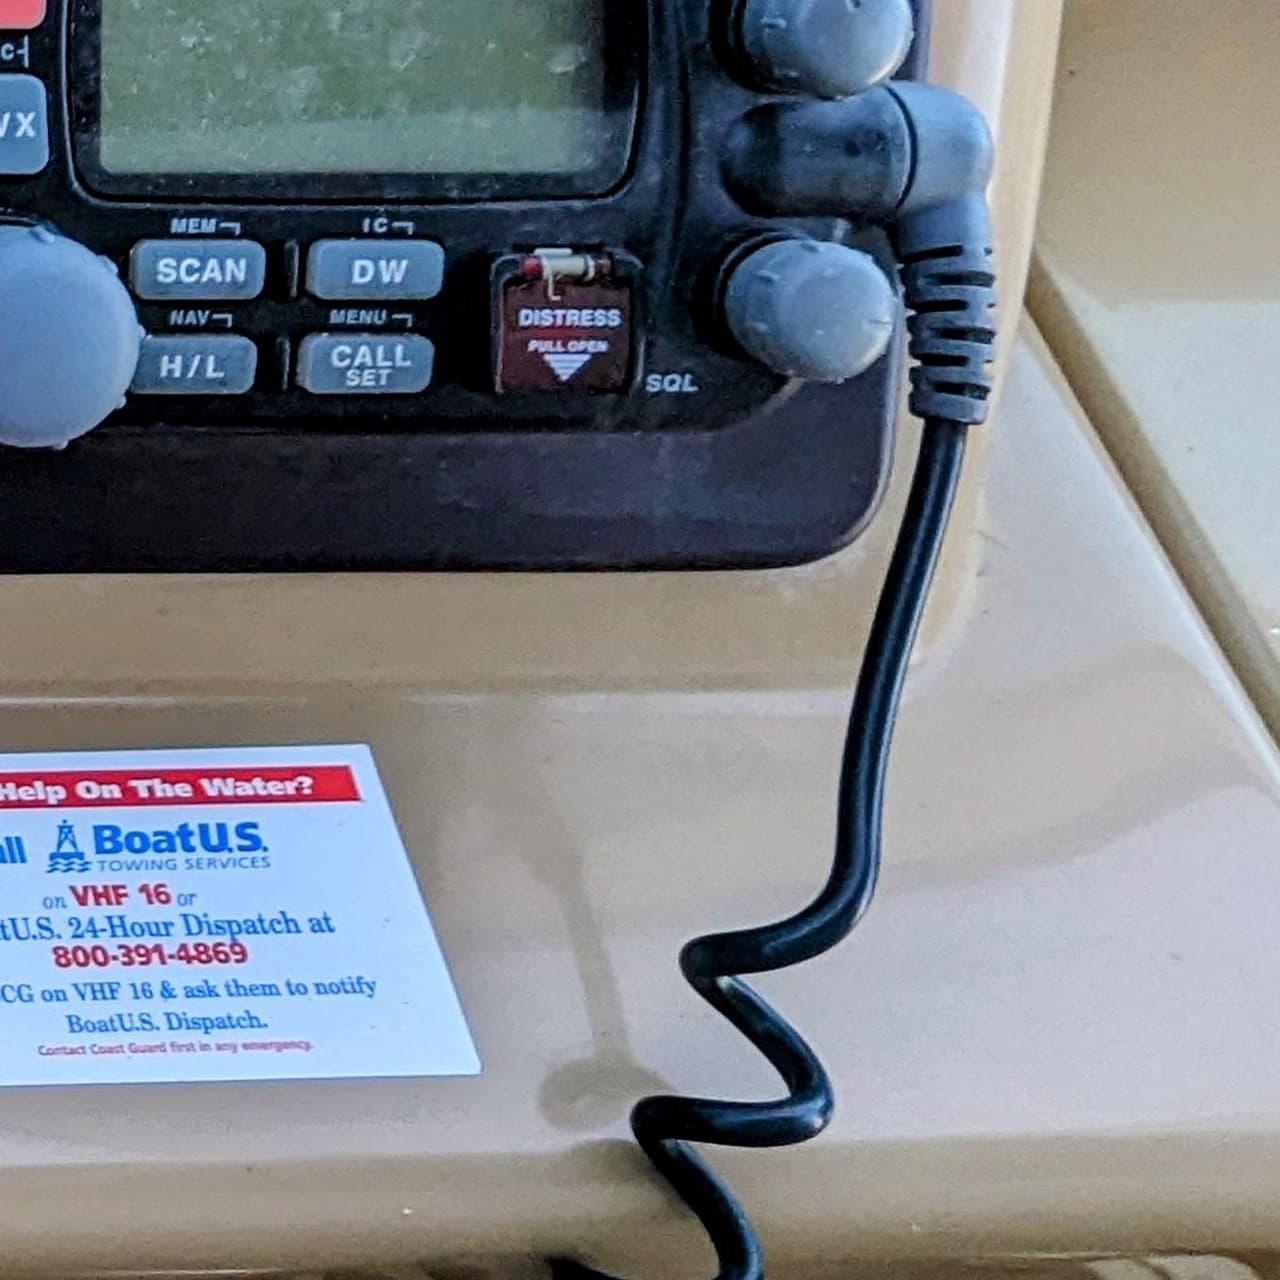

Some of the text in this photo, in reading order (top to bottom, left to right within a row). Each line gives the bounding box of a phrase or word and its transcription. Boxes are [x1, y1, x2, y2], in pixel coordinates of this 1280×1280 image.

[170, 217, 217, 233] MEM
[156, 257, 247, 283] SCAN
[351, 259, 409, 283] DW
[170, 310, 210, 326] NAV
[329, 310, 388, 325] MENU
[519, 309, 622, 327] DISTRESS
[330, 346, 412, 368] CALL
[528, 340, 610, 352] PULL OPEN
[159, 355, 225, 379] H/L
[345, 370, 393, 386] SET
[646, 374, 699, 392] SQL
[75, 780, 122, 799] On
[129, 778, 193, 798] The
[198, 776, 313, 796] Water?
[98, 855, 271, 872] TOWING SERVICES
[42, 883, 197, 910] on VHF 16 or
[68, 914, 175, 939] 24-Hour
[179, 910, 303, 941] Dispatch
[308, 911, 336, 934] at
[52, 941, 248, 968] 800-391-4869
[41, 988, 69, 1002] on
[71, 981, 122, 1001] VHF
[129, 982, 154, 1000] 16
[160, 980, 178, 999] &
[183, 979, 220, 999] ask
[224, 978, 282, 997] them
[285, 978, 309, 996] to
[312, 975, 377, 998] notify
[65, 1010, 269, 1035] BoatU.S. Dispatch.
[38, 1045, 86, 1056] Contact
[89, 1044, 124, 1055] Coast
[127, 1042, 166, 1053] Guard
[198, 1041, 213, 1052] in
[215, 1041, 239, 1054] any
